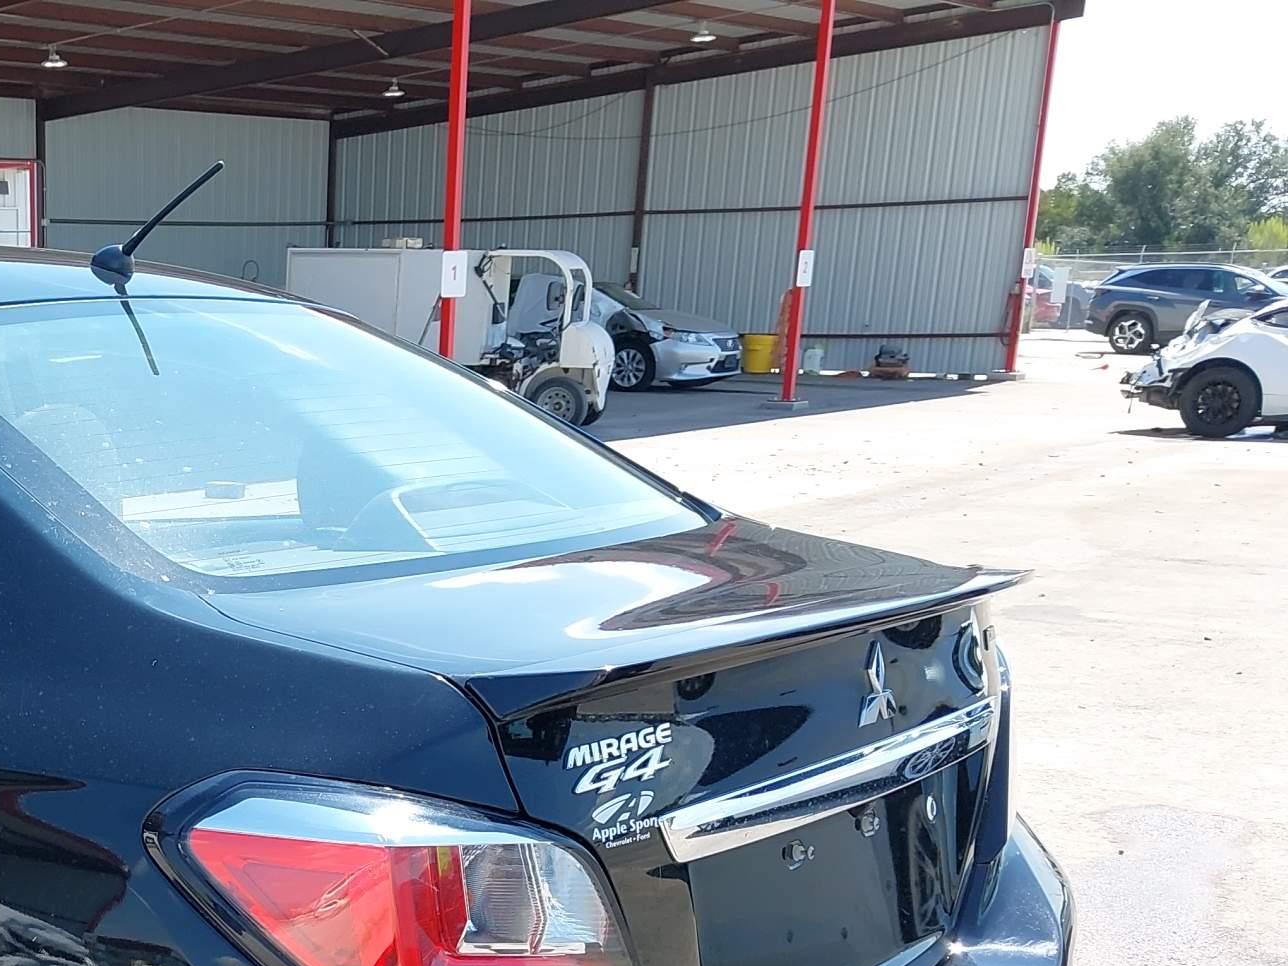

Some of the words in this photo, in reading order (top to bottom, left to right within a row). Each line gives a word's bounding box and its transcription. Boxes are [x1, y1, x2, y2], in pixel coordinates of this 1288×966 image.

[451, 265, 457, 281] 1
[566, 722, 673, 769] MIRAGE
[574, 745, 672, 794] G4
[592, 823, 627, 842] Apple
[605, 837, 633, 849] Chevrolet
